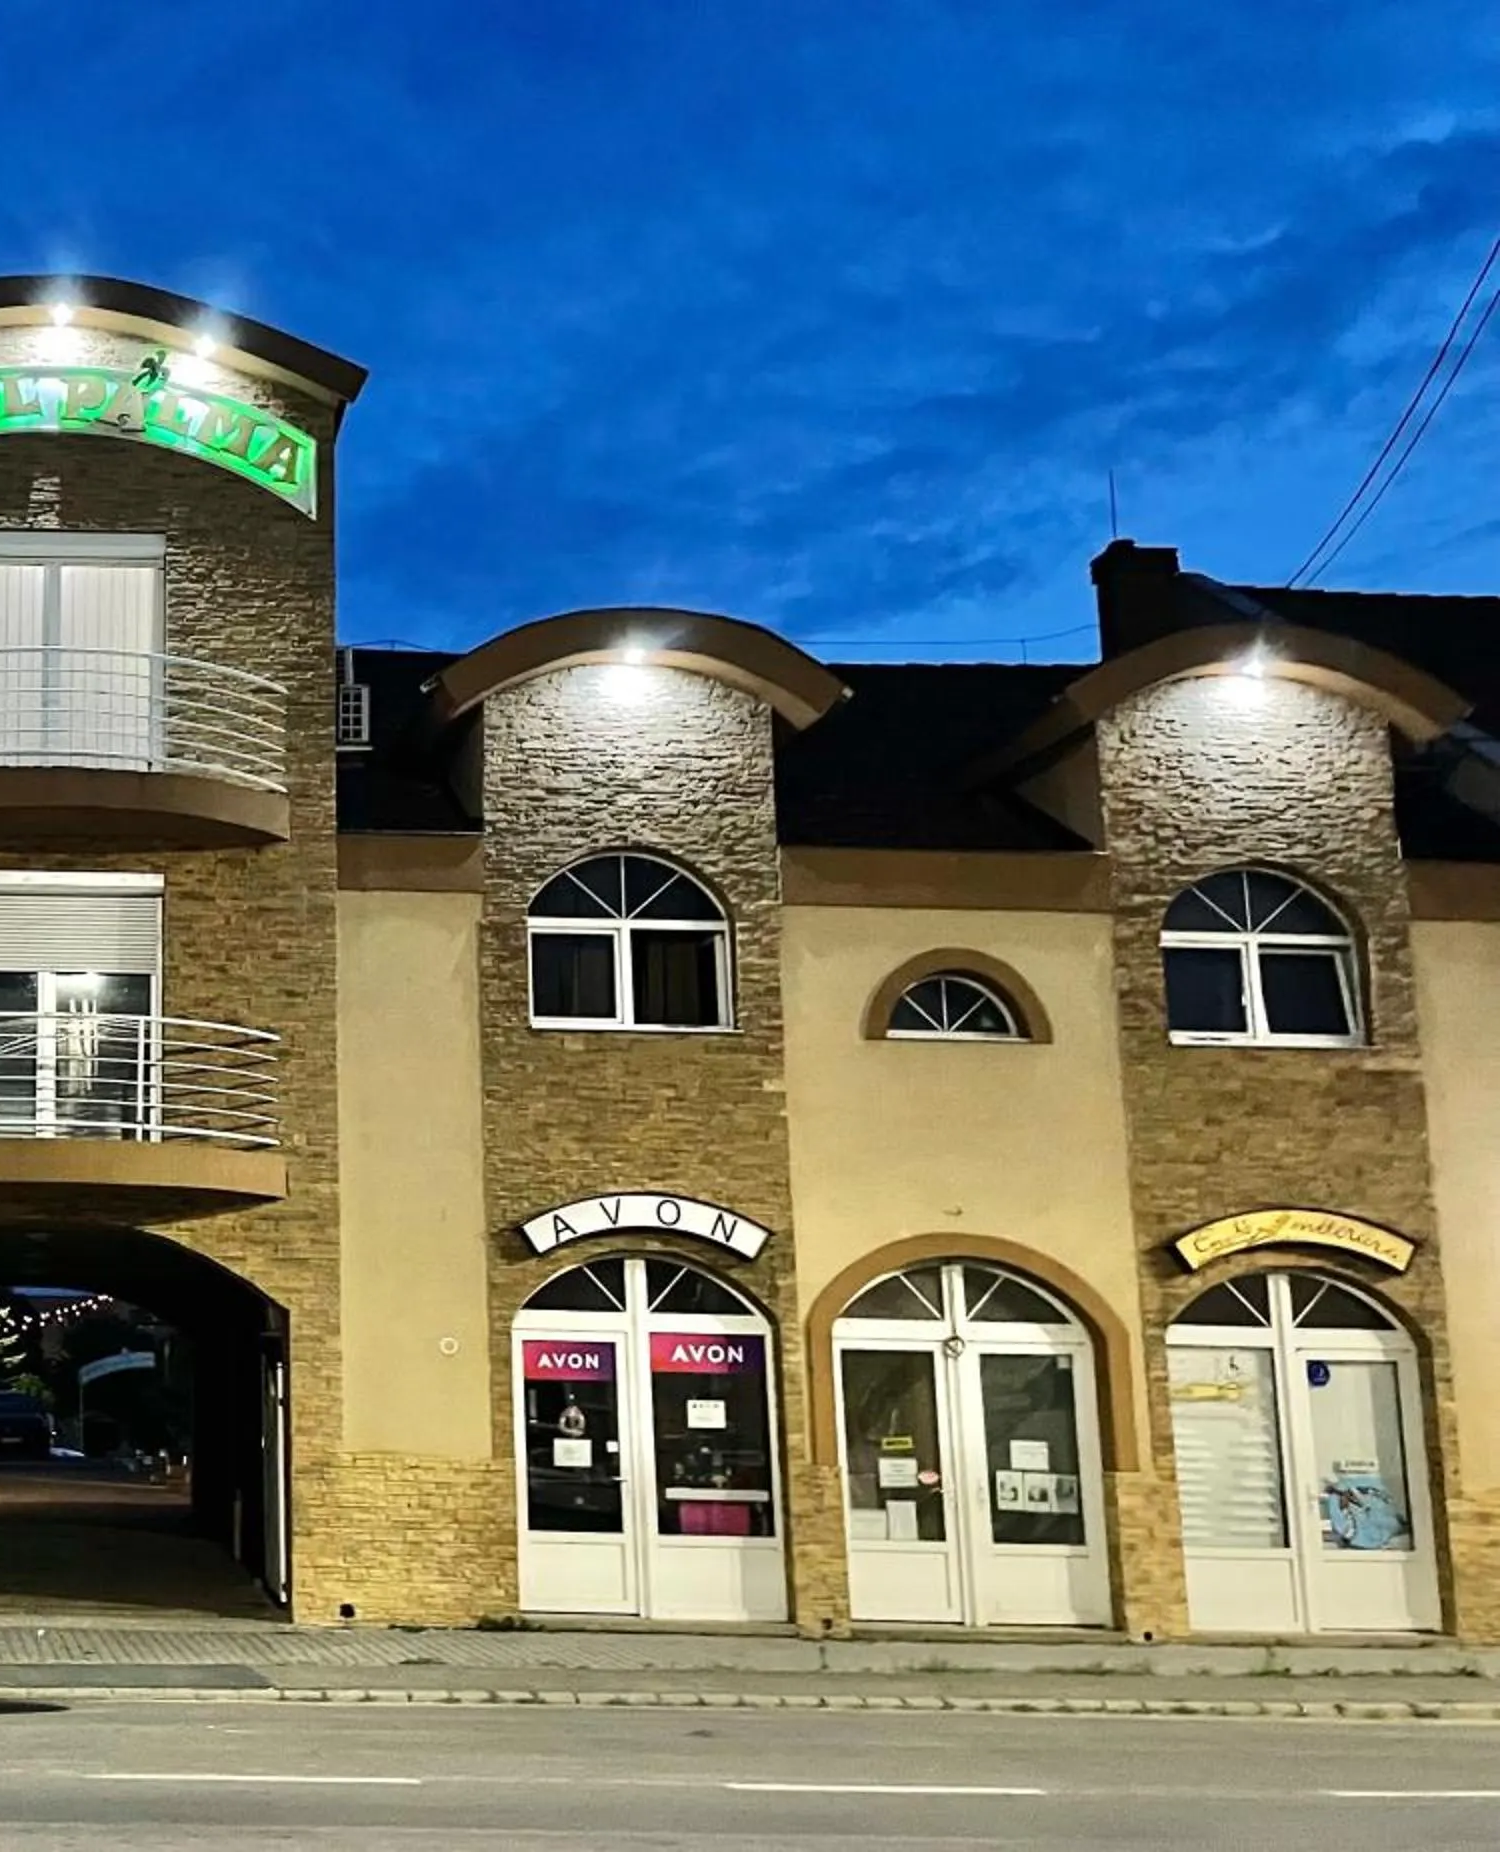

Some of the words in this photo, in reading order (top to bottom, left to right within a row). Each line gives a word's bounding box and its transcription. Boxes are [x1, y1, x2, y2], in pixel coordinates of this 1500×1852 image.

[61, 373, 299, 484] PALMA
[552, 1197, 738, 1243] AVON
[537, 1352, 600, 1370] AVON
[671, 1344, 744, 1364] AVON
